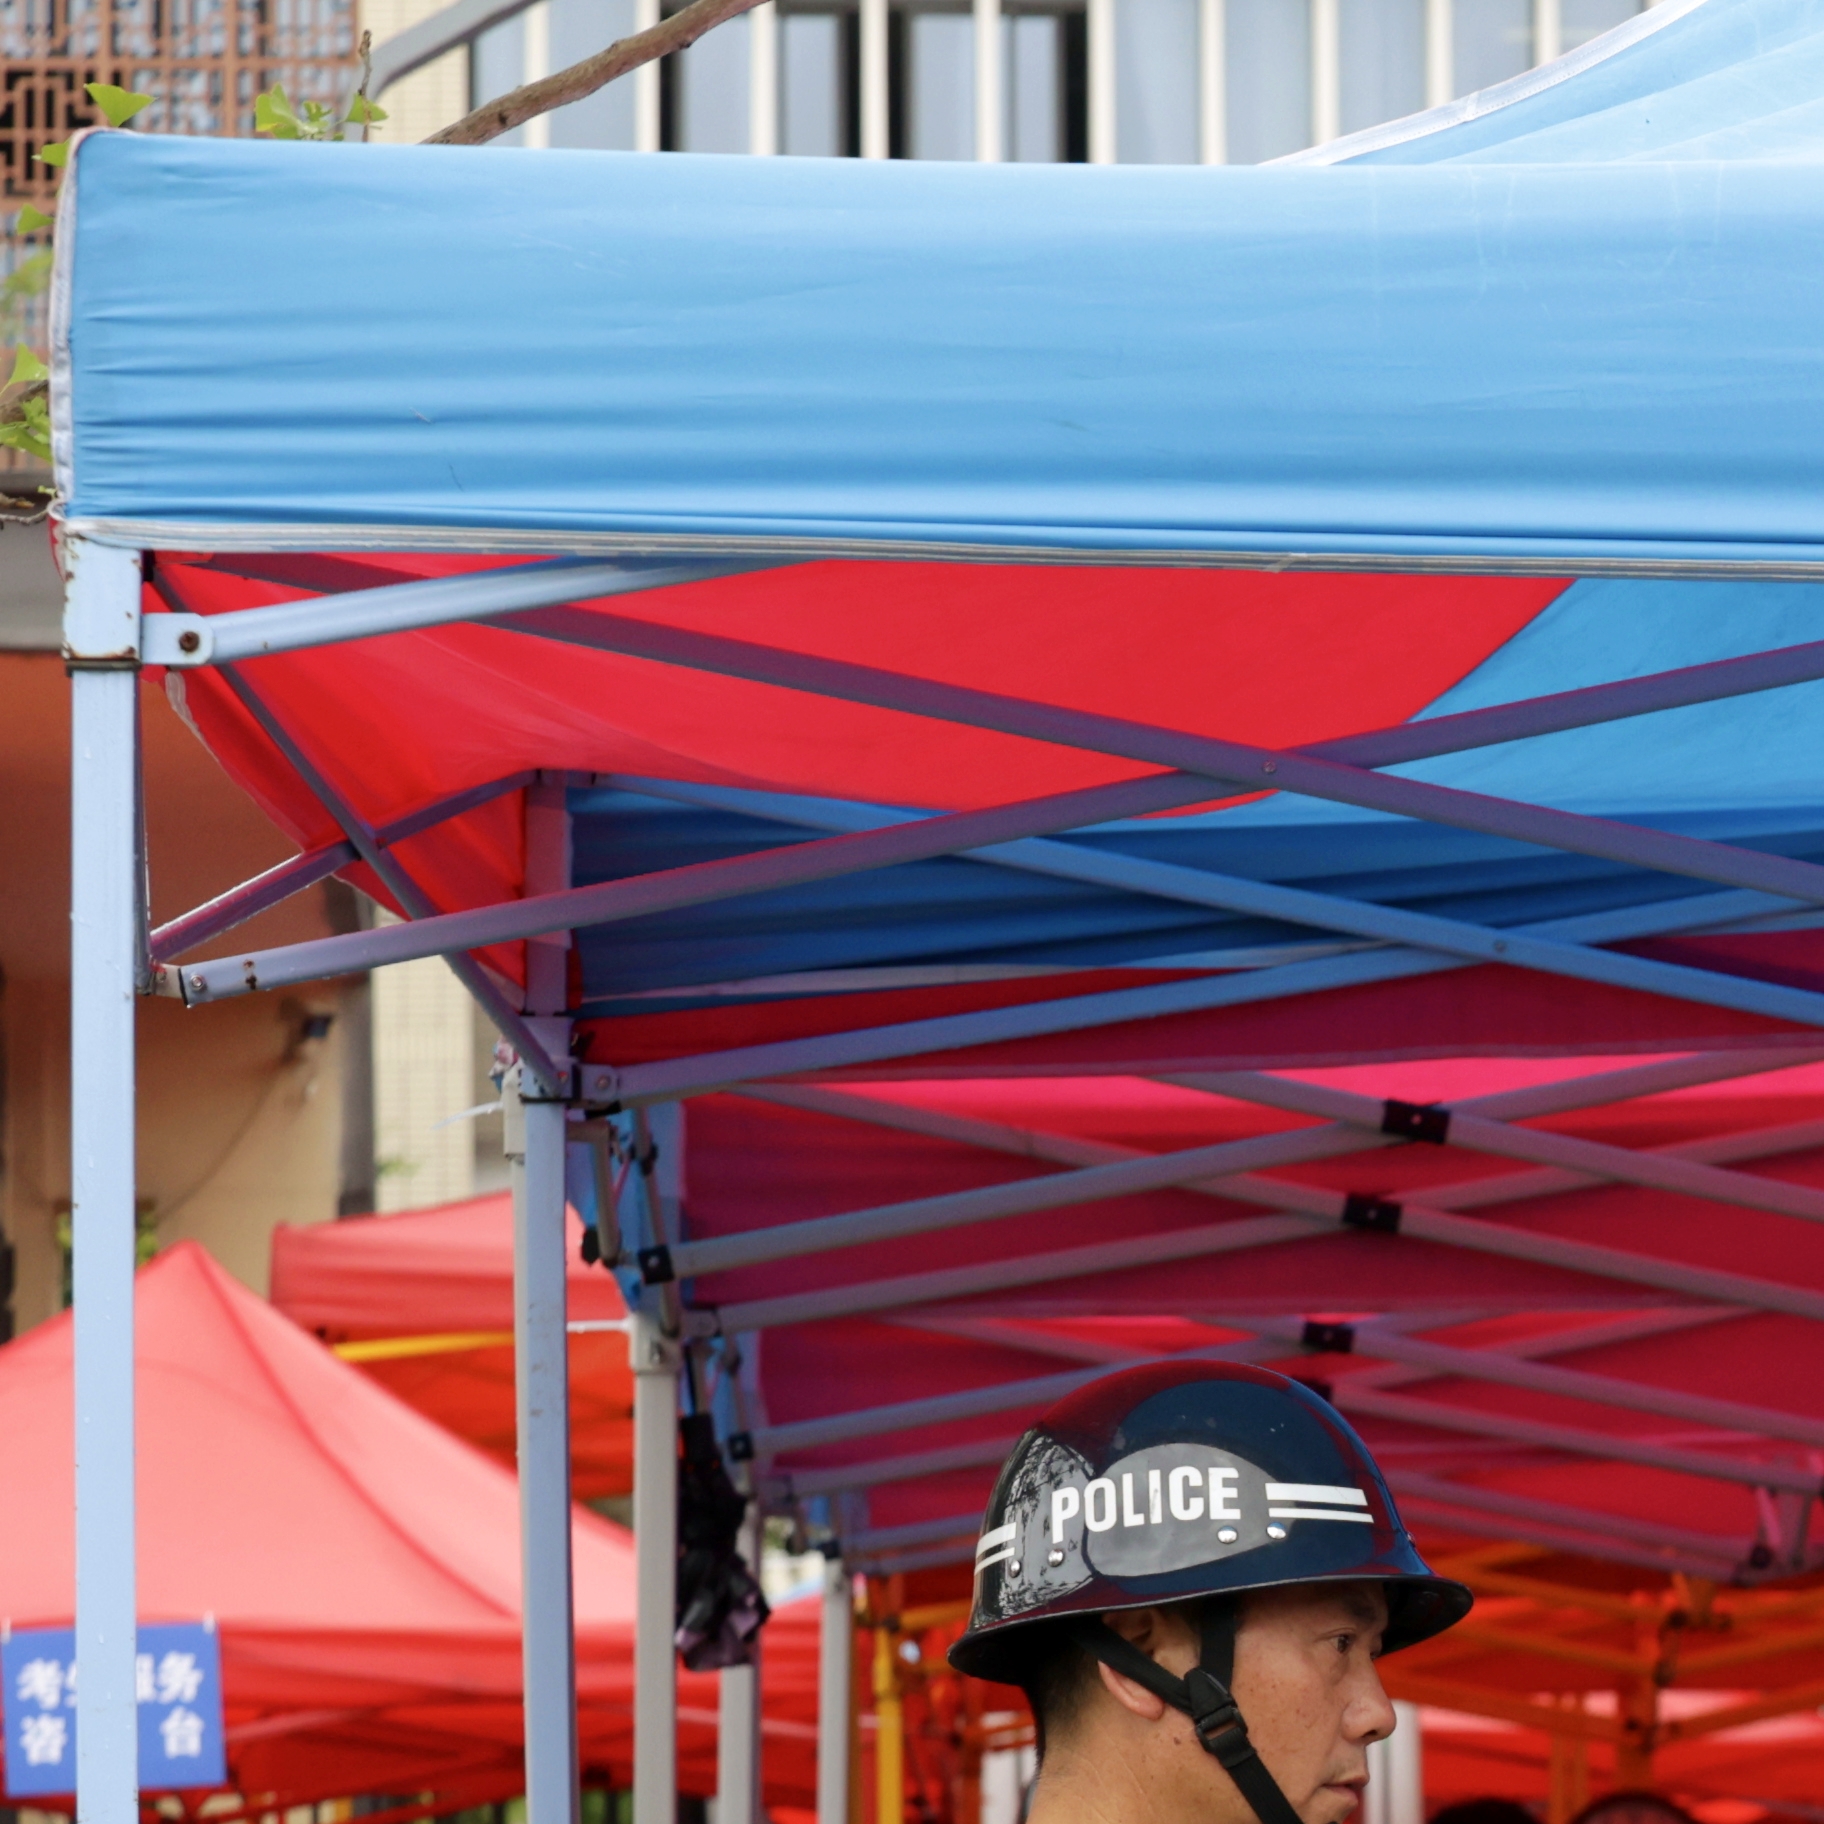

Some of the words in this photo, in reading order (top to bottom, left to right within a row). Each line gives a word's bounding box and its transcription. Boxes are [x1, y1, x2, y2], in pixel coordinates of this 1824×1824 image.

[1051, 1465, 1242, 1545] POLICE
[16, 1650, 204, 1710] 考务
[20, 1706, 205, 1766] 咨台
